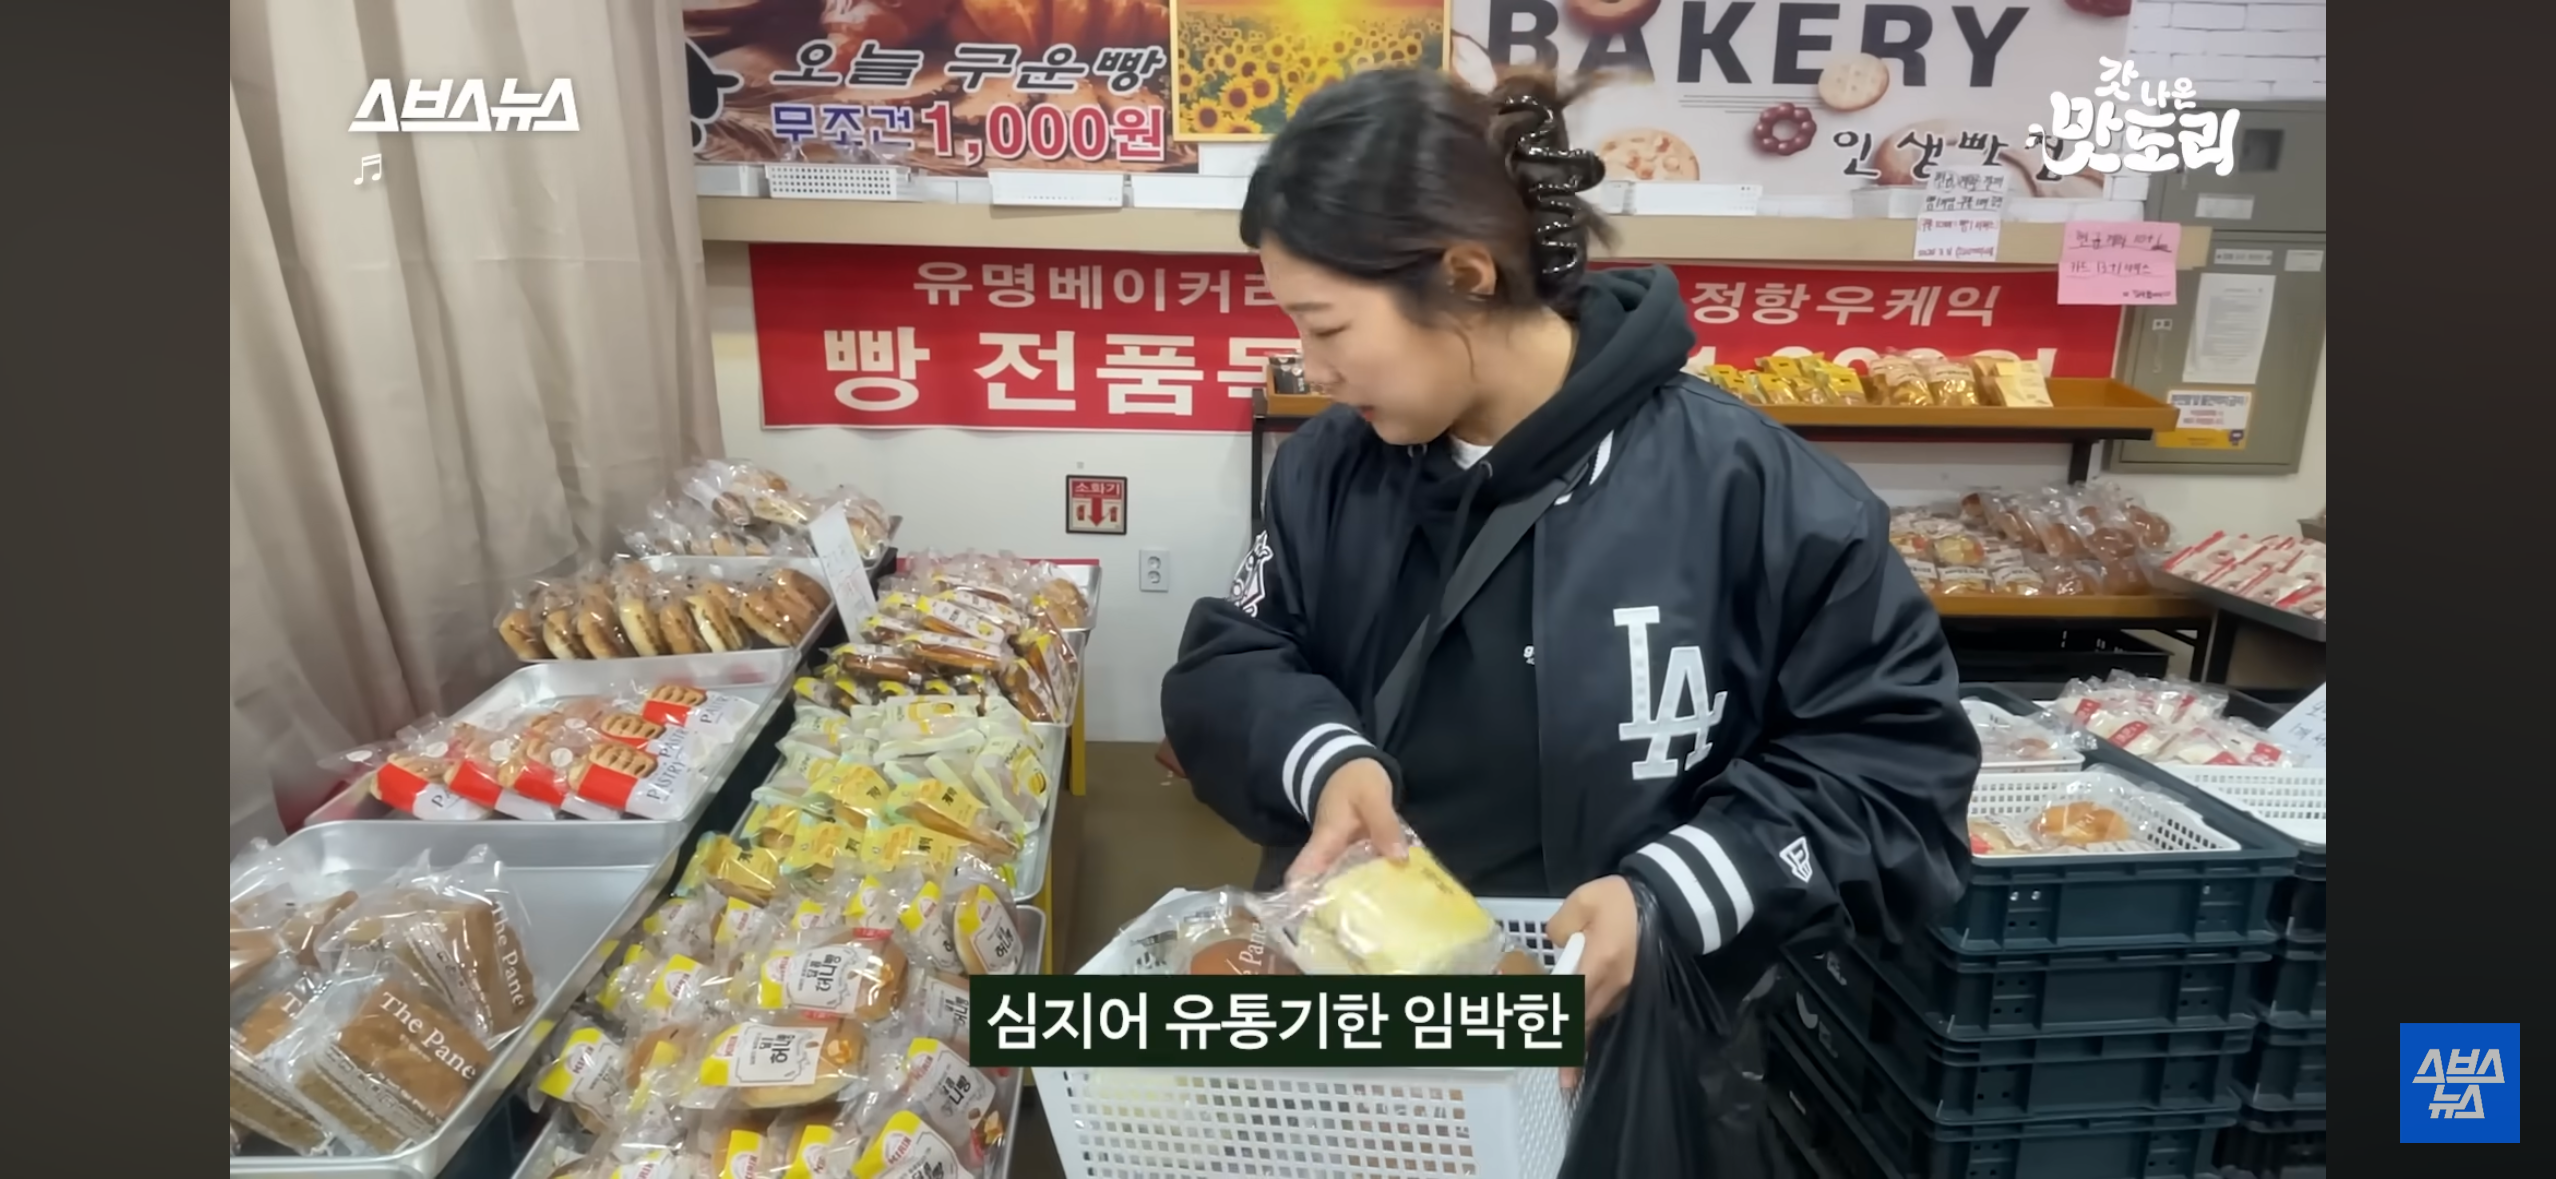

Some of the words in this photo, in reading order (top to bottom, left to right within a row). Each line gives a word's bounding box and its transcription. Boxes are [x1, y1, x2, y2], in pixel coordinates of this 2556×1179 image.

[771, 38, 924, 89] 오늘
[1488, 0, 2030, 88] BAKERY
[771, 103, 914, 149] 무조건
[921, 100, 1167, 165] 1,000원
[1690, 281, 2002, 327] 정항우케익
[824, 325, 930, 412] 빵
[1075, 482, 1120, 496] 소화기
[1612, 605, 1728, 780] LA
[502, 948, 525, 1006] Pane
[380, 991, 423, 1034] The
[421, 1026, 477, 1080] Pane
